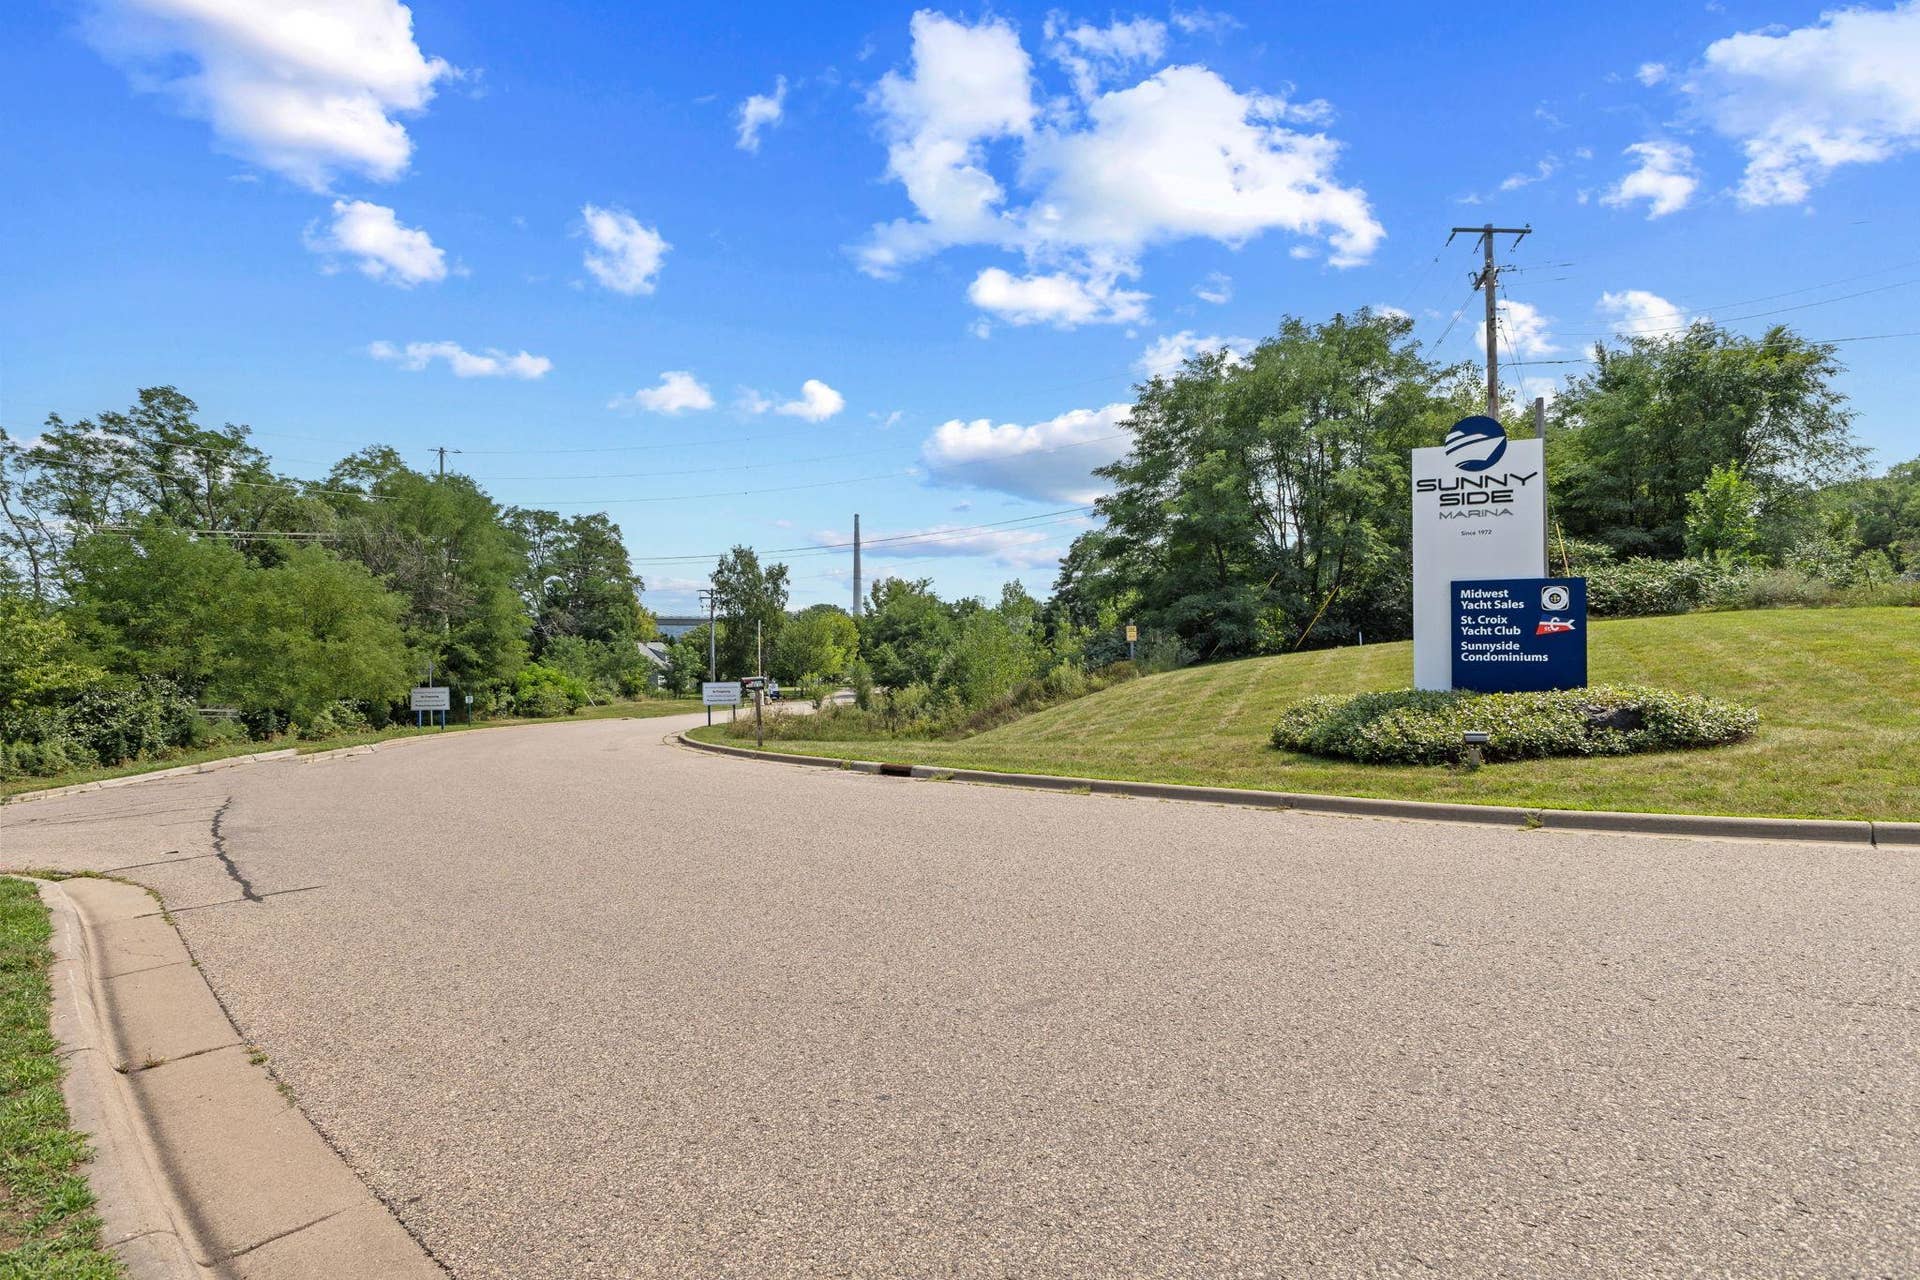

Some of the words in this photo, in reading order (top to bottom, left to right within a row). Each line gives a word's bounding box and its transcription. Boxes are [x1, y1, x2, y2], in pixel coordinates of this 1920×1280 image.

[1416, 471, 1538, 492] SUNNY
[1439, 489, 1514, 507] SIDE
[1439, 508, 1514, 520] MARINA
[1460, 589, 1509, 599] Midwest
[1461, 600, 1492, 610] Yacht
[1494, 600, 1525, 609] Sales
[1460, 615, 1476, 625] St.
[1477, 615, 1508, 624] Croix
[1461, 626, 1492, 636] Yacht
[1494, 626, 1521, 635] Club
[1460, 641, 1520, 653] Sunnyside
[1461, 652, 1549, 662] Condominiums
